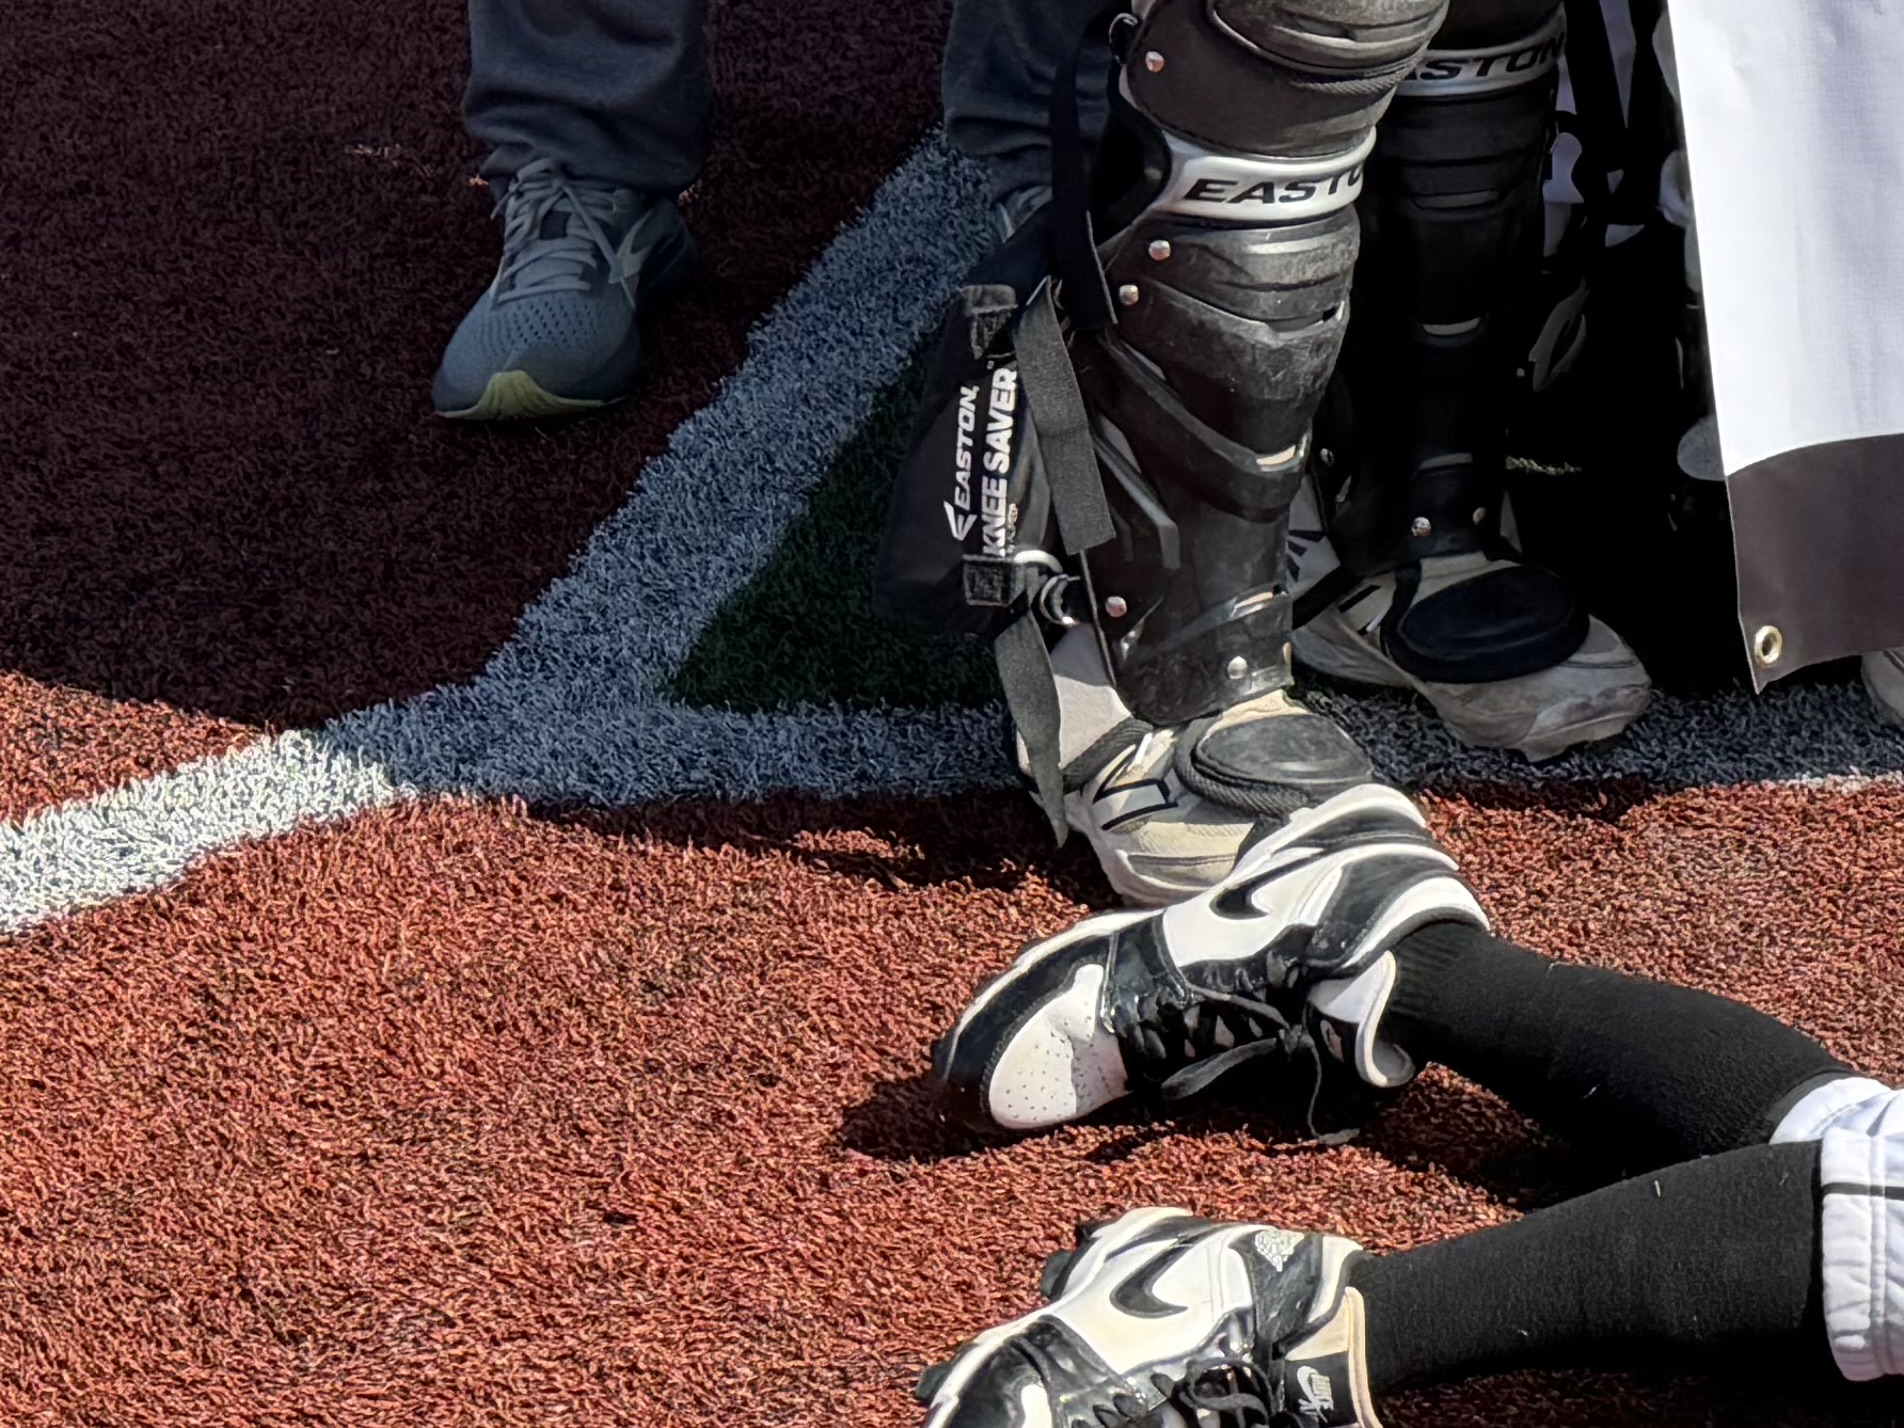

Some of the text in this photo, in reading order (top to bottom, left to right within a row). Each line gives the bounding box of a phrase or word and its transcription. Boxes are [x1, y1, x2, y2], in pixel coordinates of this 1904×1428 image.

[955, 386, 979, 511] EASTON
[981, 367, 1018, 558] KNEE SAVER
